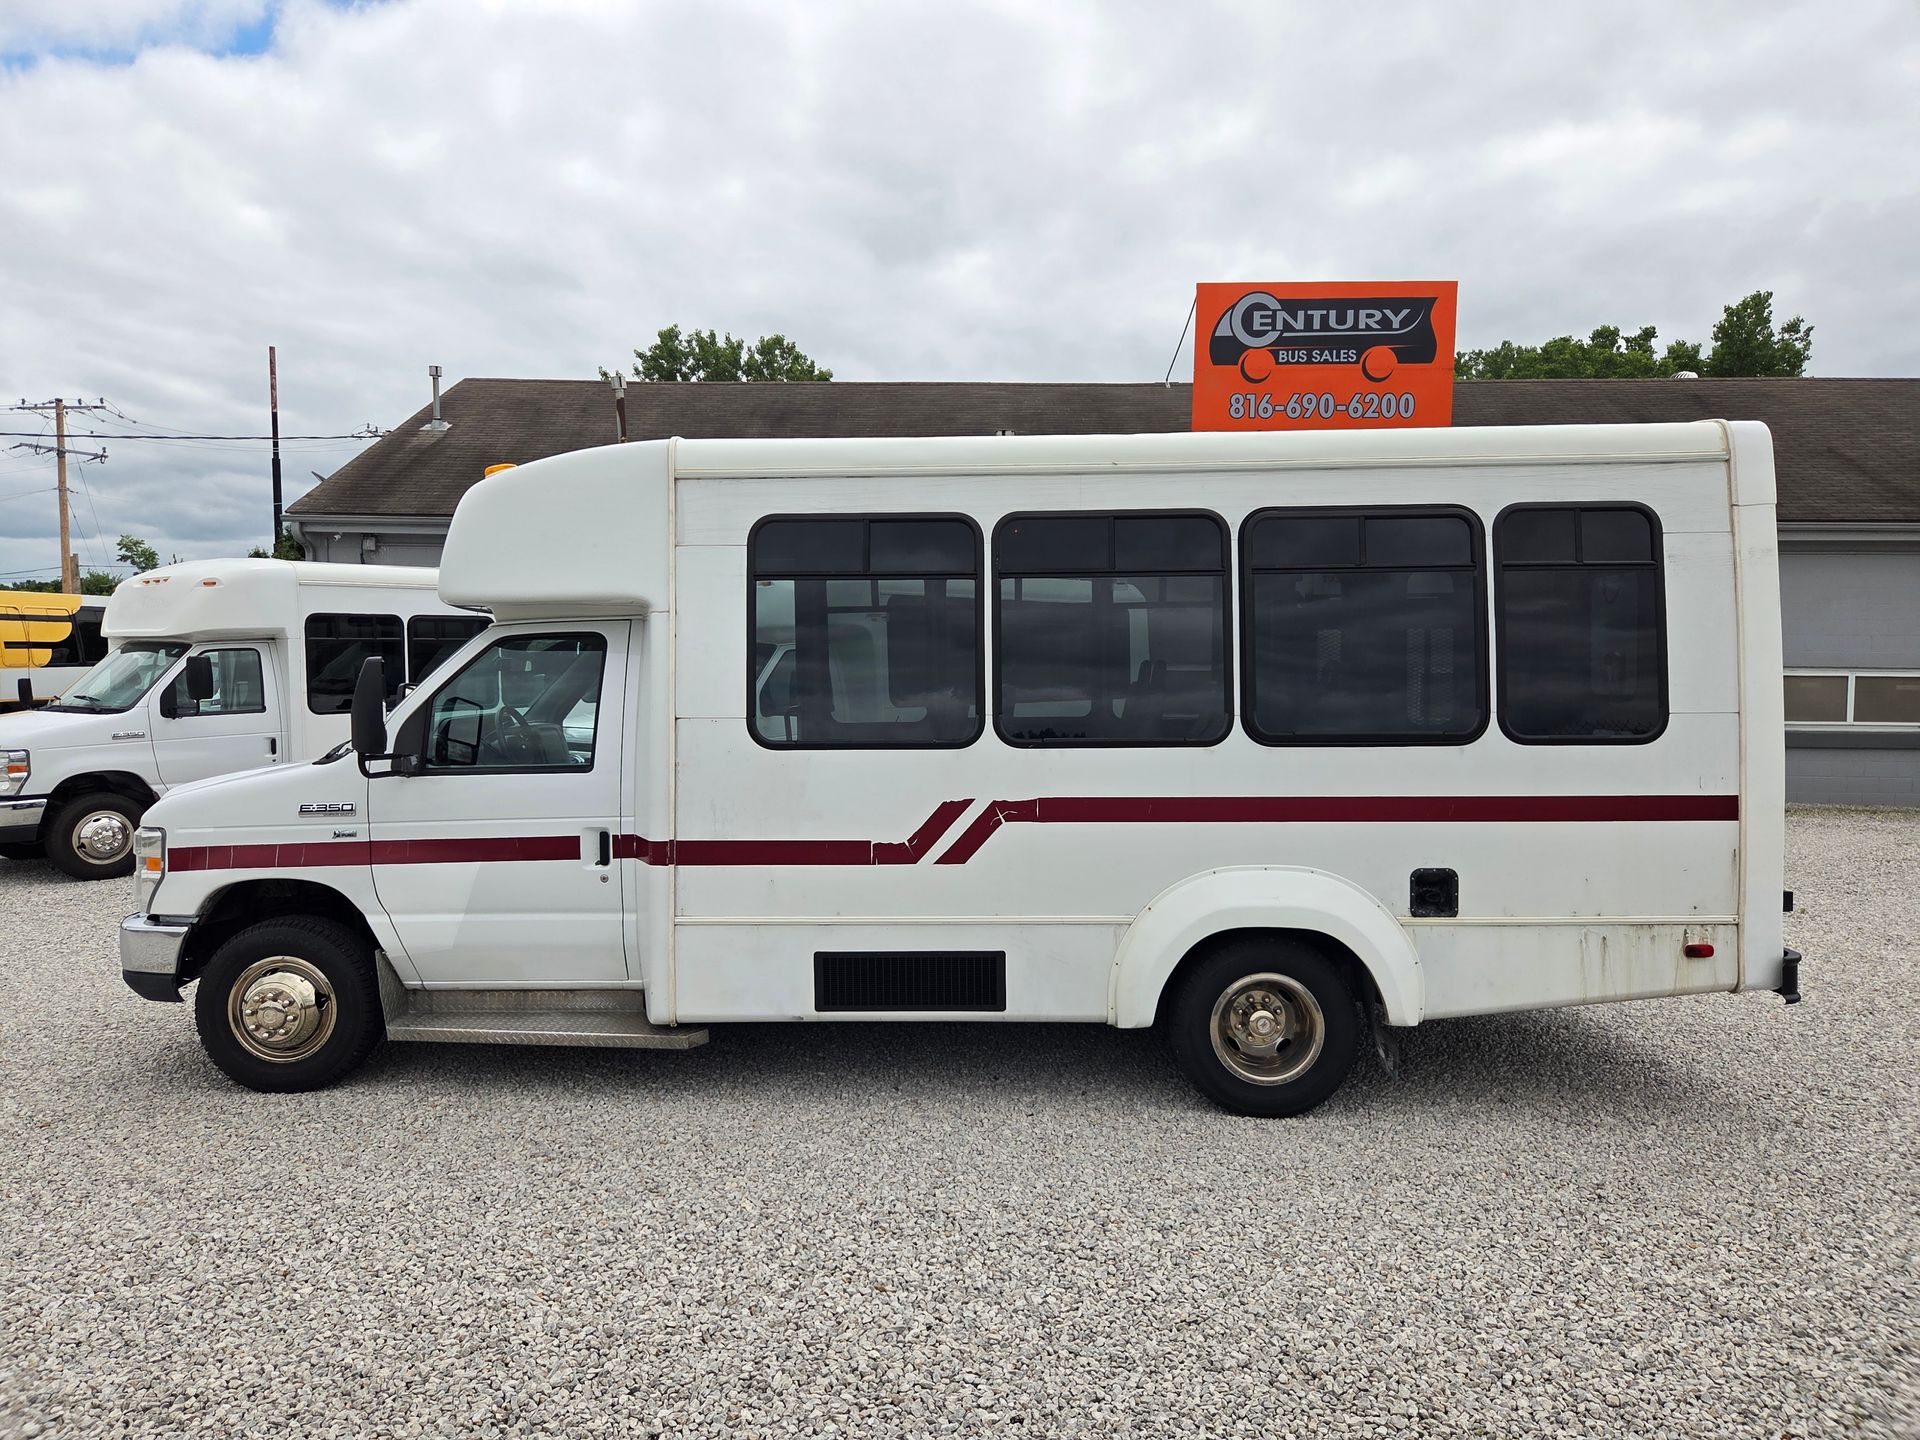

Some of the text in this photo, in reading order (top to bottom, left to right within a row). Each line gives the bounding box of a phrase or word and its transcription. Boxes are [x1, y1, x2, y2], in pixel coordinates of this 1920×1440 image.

[1231, 292, 1411, 348] CENTURY
[1278, 349, 1357, 362] BUS SALES
[1229, 392, 1415, 419] 816-690-6200
